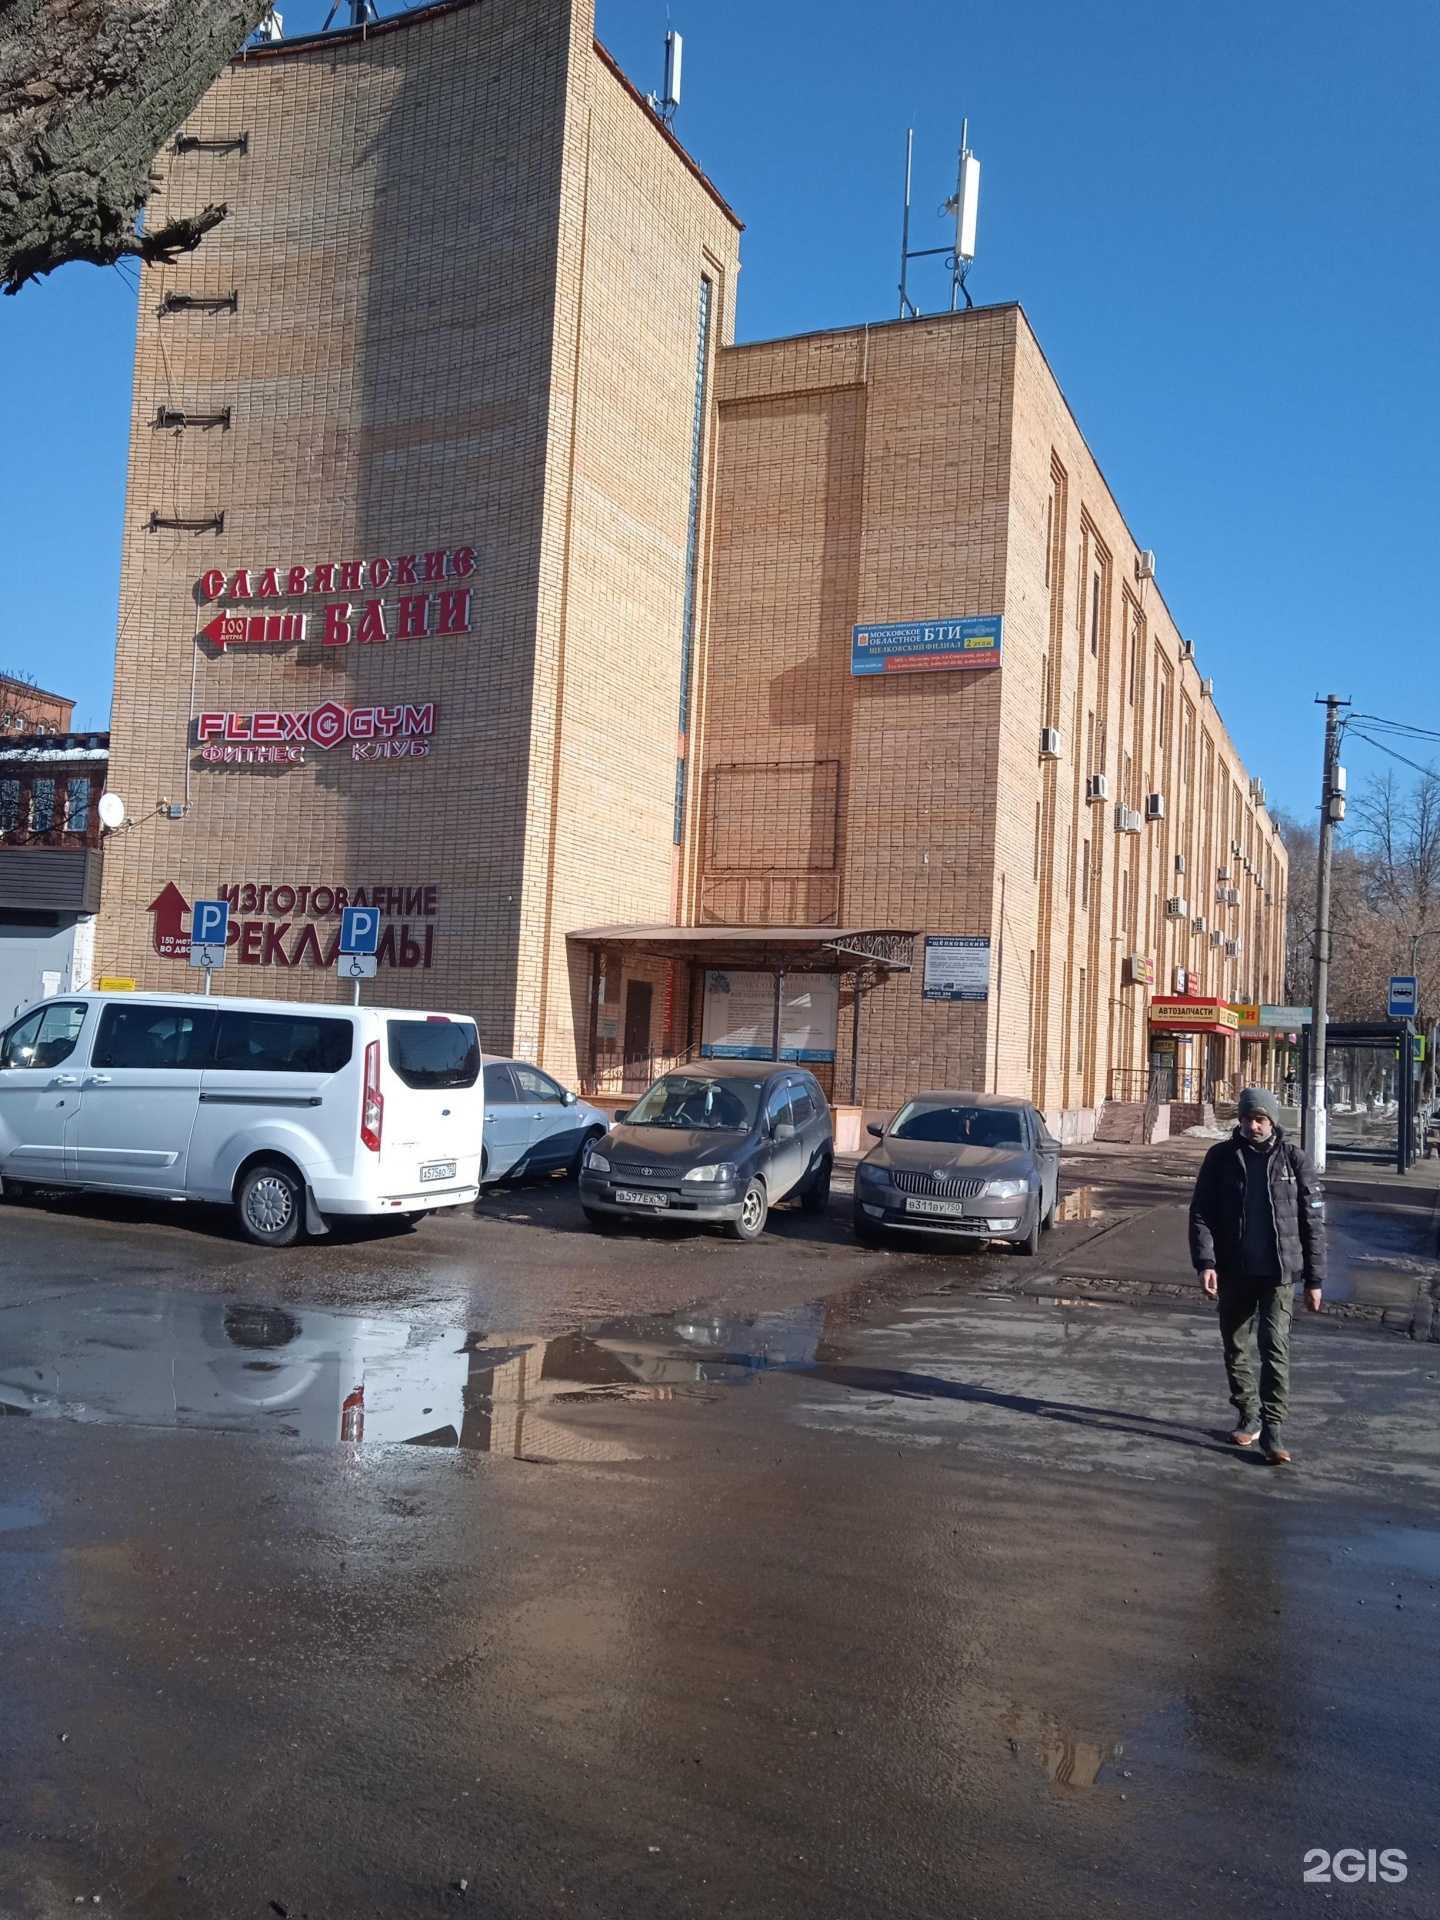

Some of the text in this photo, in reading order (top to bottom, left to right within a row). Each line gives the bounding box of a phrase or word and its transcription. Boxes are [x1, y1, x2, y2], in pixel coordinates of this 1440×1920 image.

[220, 619, 244, 633] 100
[321, 588, 474, 647] БАНИ
[924, 625, 961, 641] БТИ
[350, 702, 434, 737] GYM
[202, 739, 430, 763] ФИТНЕС КЛУБ
[221, 883, 437, 916] ИЗГОТОВЛЕНИЕ
[161, 936, 175, 944] 150
[174, 945, 192, 953] ДВО
[226, 920, 434, 968] РЕКЛЫ
[1158, 1007, 1213, 1015] АВТОЗАПЧАСТИ
